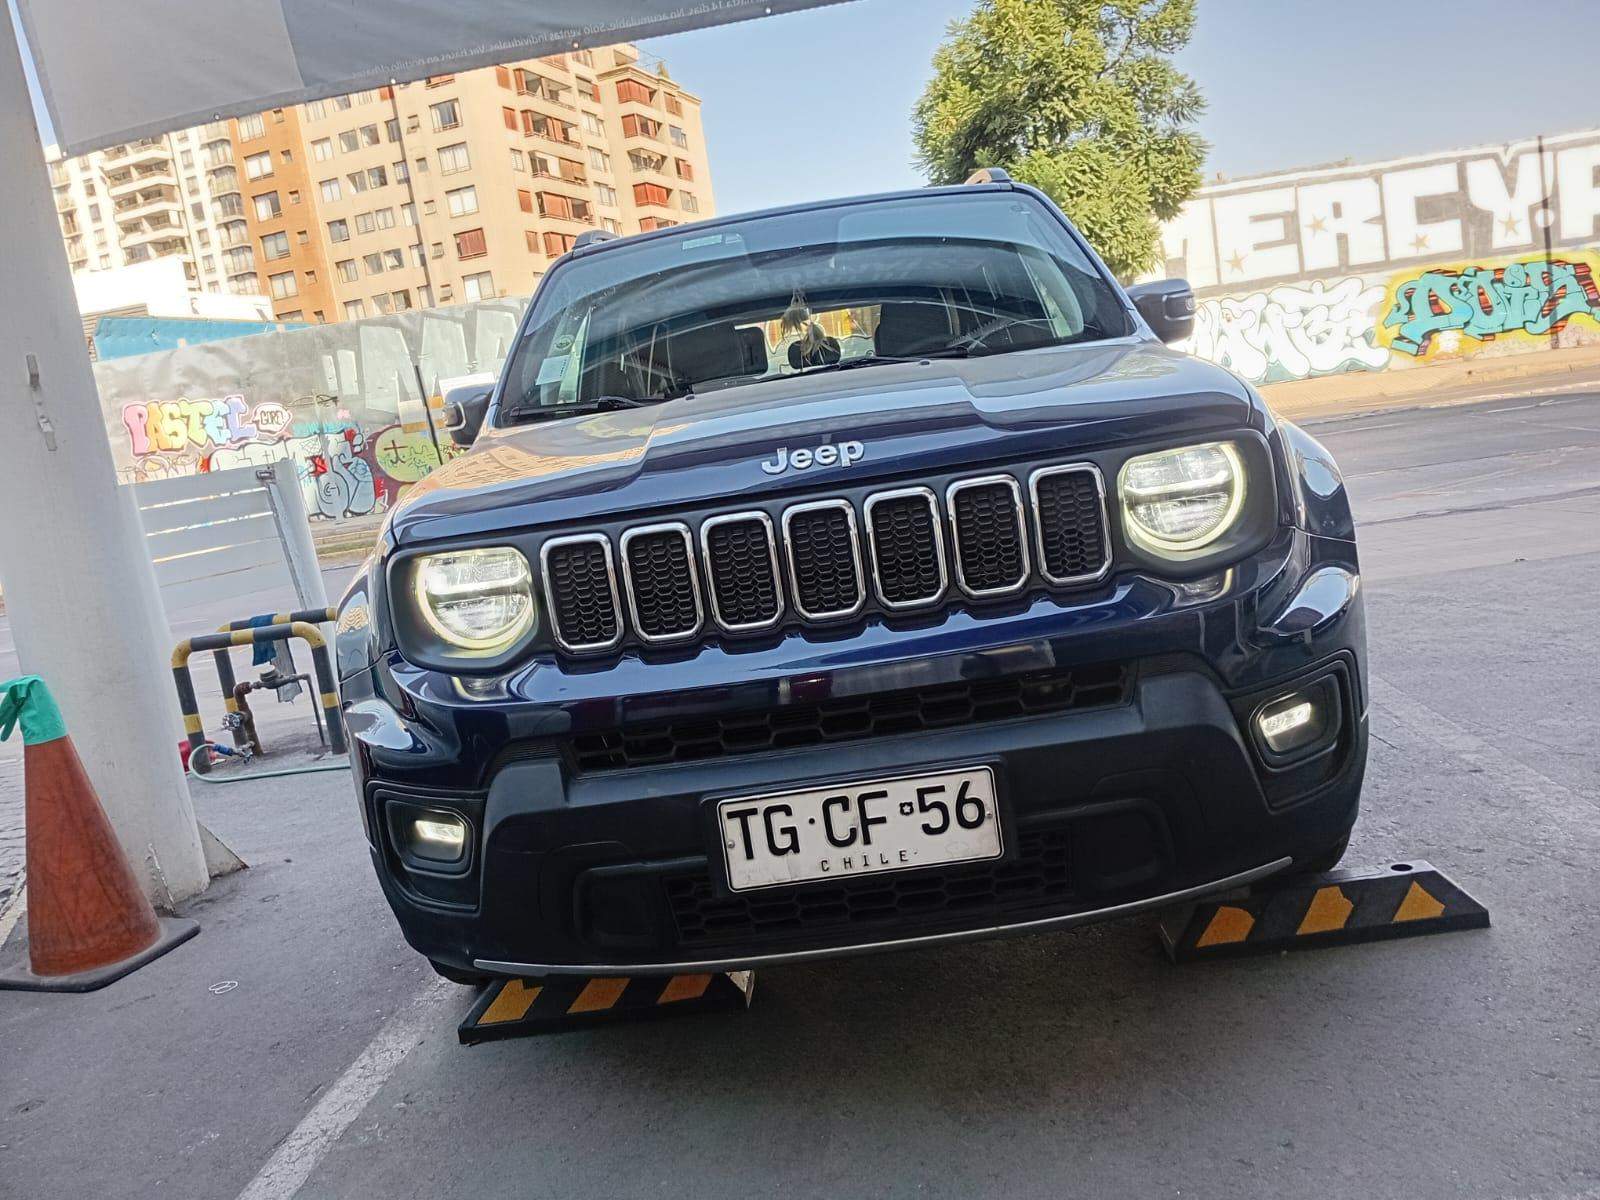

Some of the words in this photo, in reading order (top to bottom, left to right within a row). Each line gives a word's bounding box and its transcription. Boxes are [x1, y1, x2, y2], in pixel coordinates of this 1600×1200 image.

[122, 394, 258, 457] PASTEL
[761, 440, 865, 475] Jeep
[820, 850, 909, 872] CHILE
